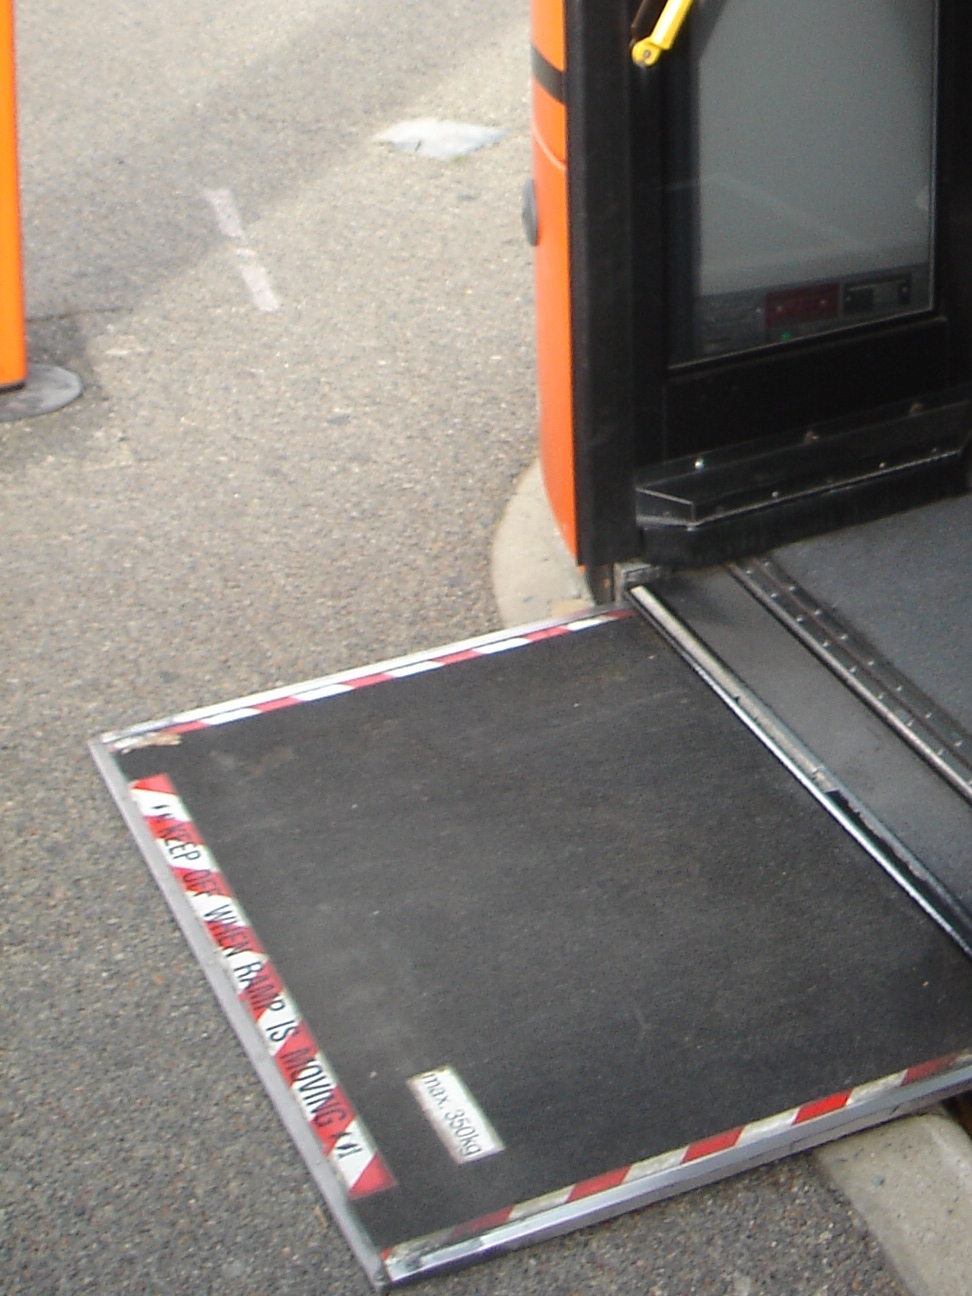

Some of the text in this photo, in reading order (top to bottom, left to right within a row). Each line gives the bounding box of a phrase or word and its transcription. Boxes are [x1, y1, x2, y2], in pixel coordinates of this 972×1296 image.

[159, 822, 347, 1128] KEEP OFF WHEN RAMP IS MOVING
[422, 1072, 483, 1157] max. 350kg
